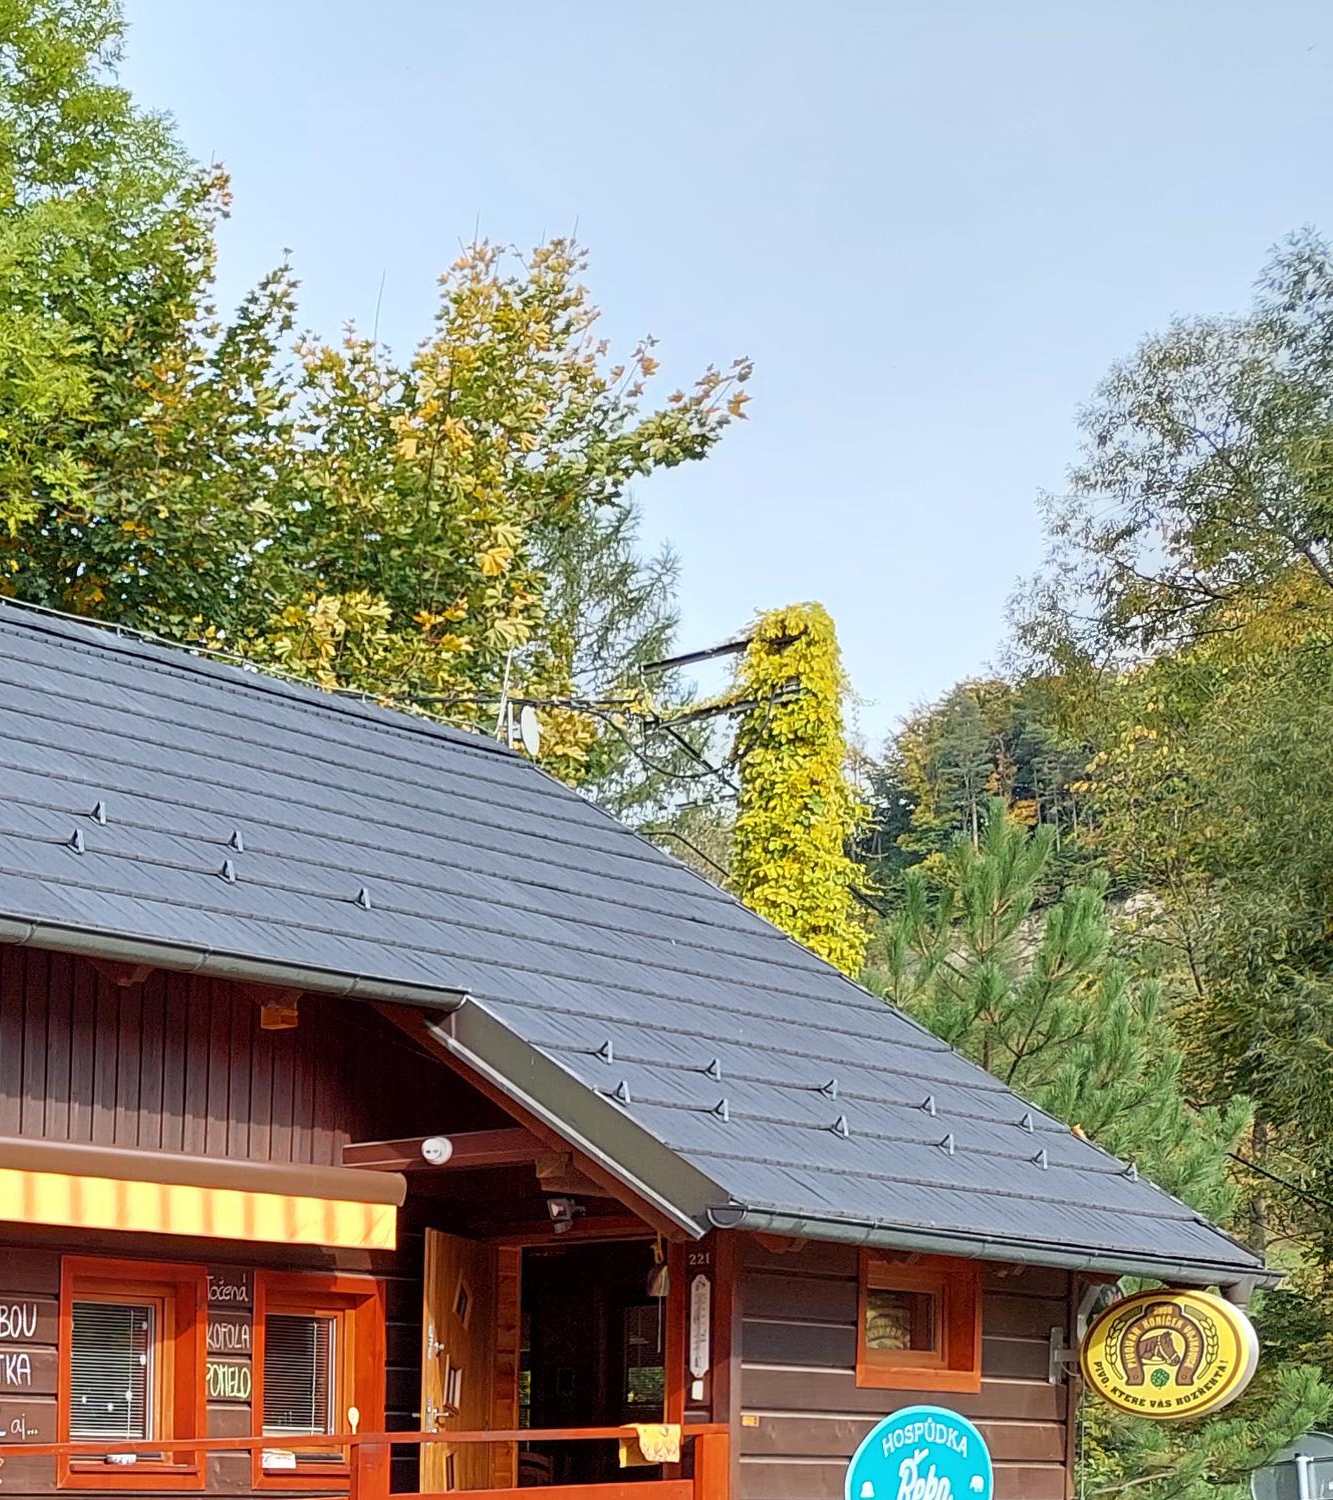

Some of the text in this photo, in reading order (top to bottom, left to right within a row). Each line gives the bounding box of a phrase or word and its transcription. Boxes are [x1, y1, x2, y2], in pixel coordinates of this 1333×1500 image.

[688, 1252, 710, 1265] 221
[206, 1322, 250, 1349] KOFOLA
[206, 1363, 251, 1398] POMELO
[1110, 1386, 1147, 1408] KTERÉ
[1149, 1398, 1173, 1409] VÁS
